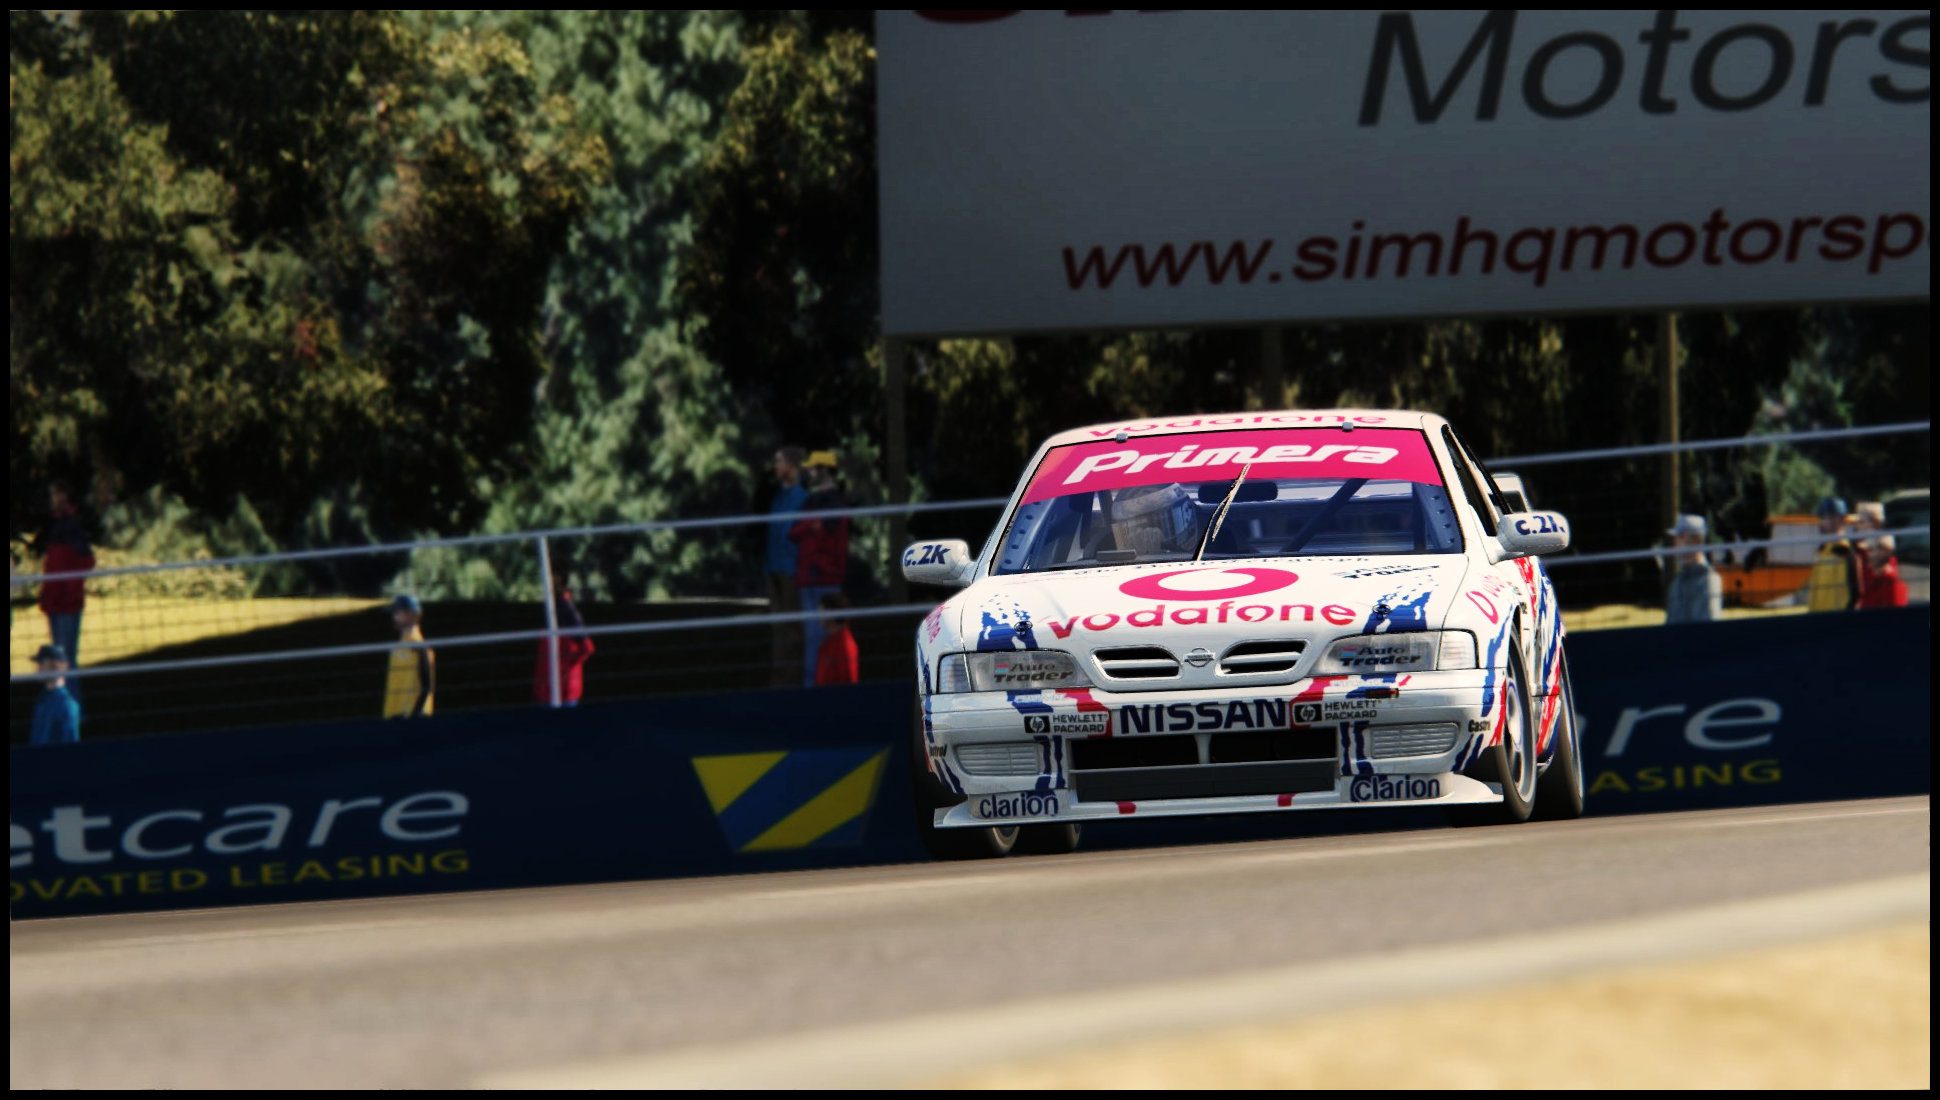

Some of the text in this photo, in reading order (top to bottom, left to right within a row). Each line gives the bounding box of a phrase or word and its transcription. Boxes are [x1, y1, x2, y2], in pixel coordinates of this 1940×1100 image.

[1061, 208, 1930, 290] www.simhqmotorsp
[1089, 415, 1387, 437] vodafone
[1062, 445, 1399, 485] Primera
[1049, 602, 1357, 639] vodafone
[1357, 647, 1406, 655] Auto
[1340, 655, 1421, 666] Trader
[1008, 662, 1056, 672] Auto
[994, 671, 1074, 683] Trader
[1324, 700, 1377, 711] HEWLETT
[1052, 713, 1106, 723] HEWLETT
[1119, 698, 1287, 734] NISSAN
[1324, 710, 1378, 720] PACKARD
[1053, 723, 1105, 733] PACKARD
[1577, 697, 1782, 757] re
[230, 850, 470, 888] LEASING
